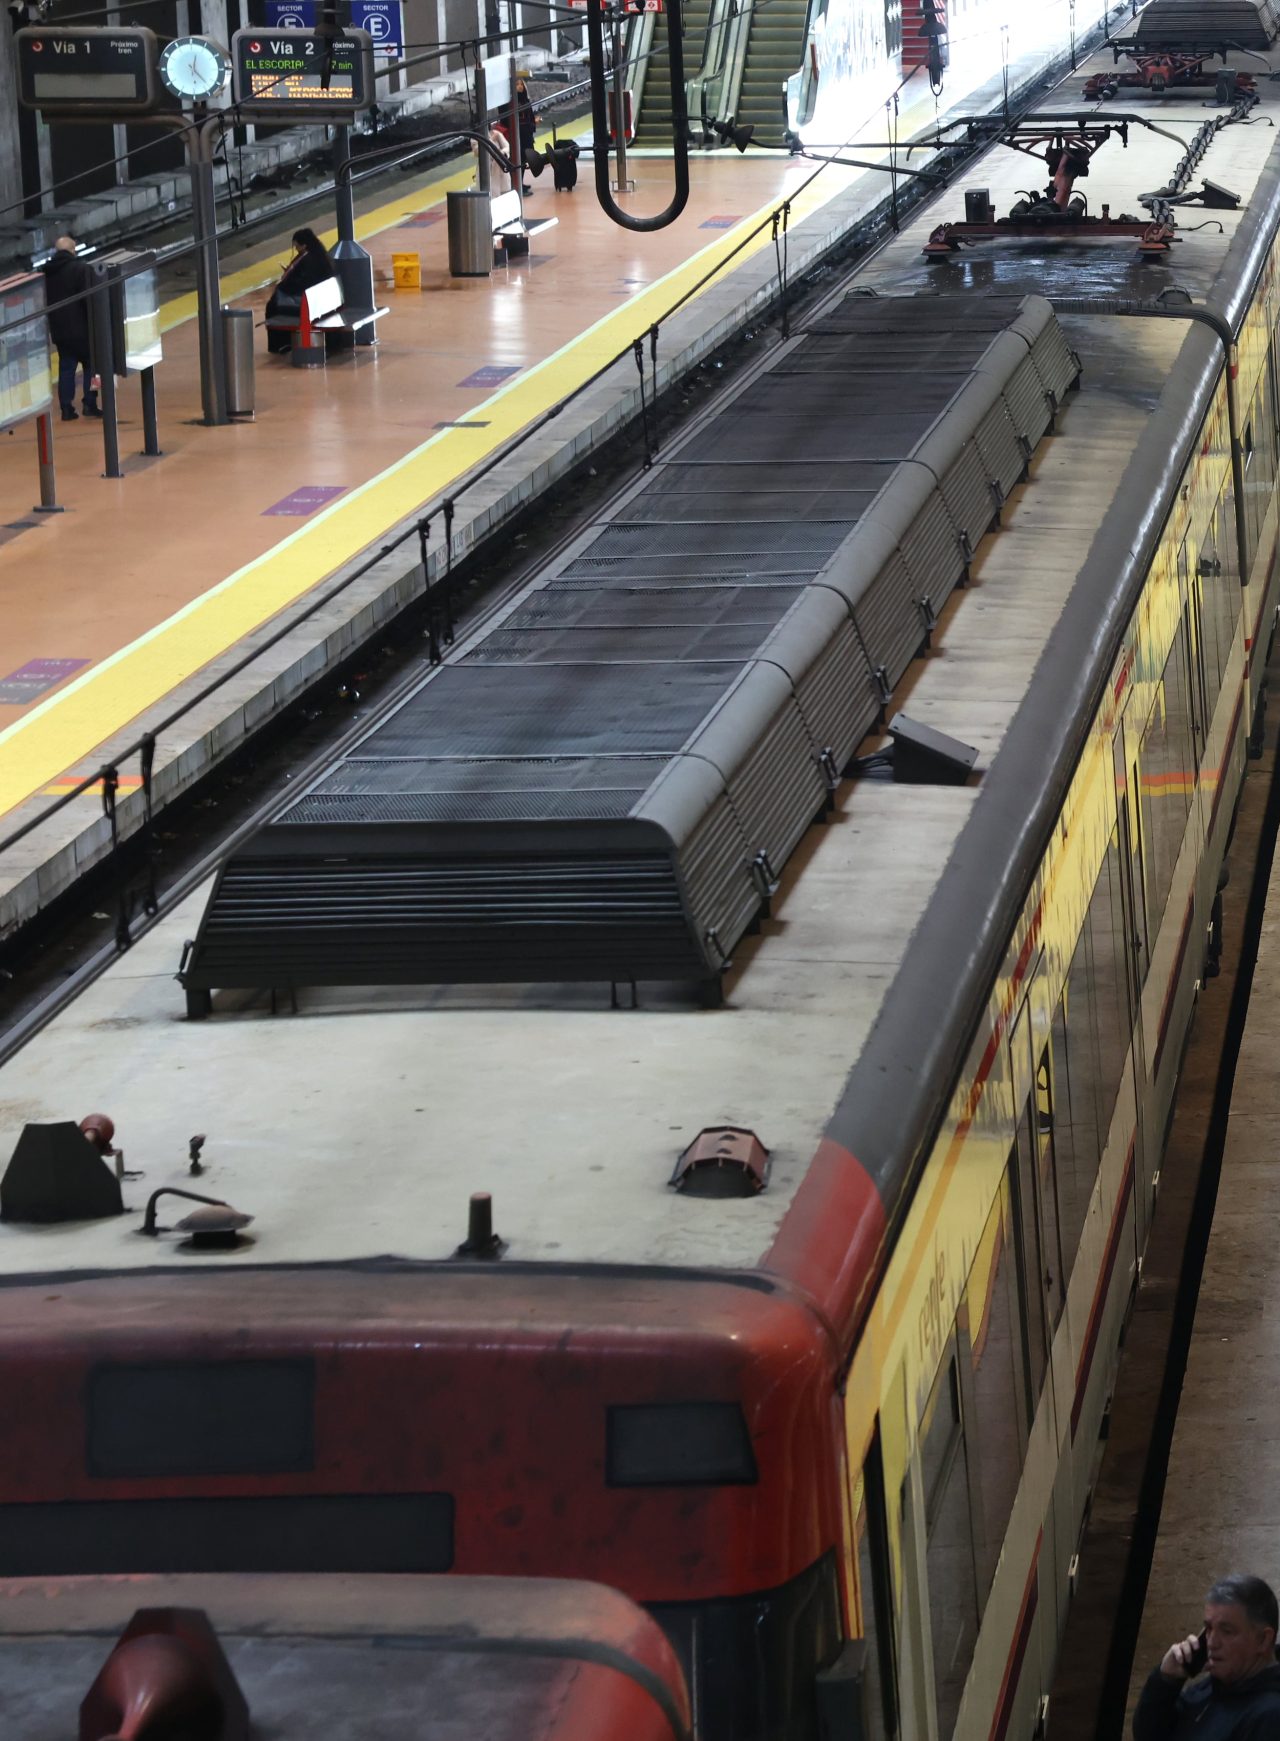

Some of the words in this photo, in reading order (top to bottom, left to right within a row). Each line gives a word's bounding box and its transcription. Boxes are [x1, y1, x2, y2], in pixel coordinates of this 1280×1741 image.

[370, 17, 383, 36] E
[84, 41, 90, 54] 1
[270, 41, 293, 55] Vía
[305, 42, 314, 55] 2
[333, 41, 355, 49] róximo
[246, 60, 257, 69] EL
